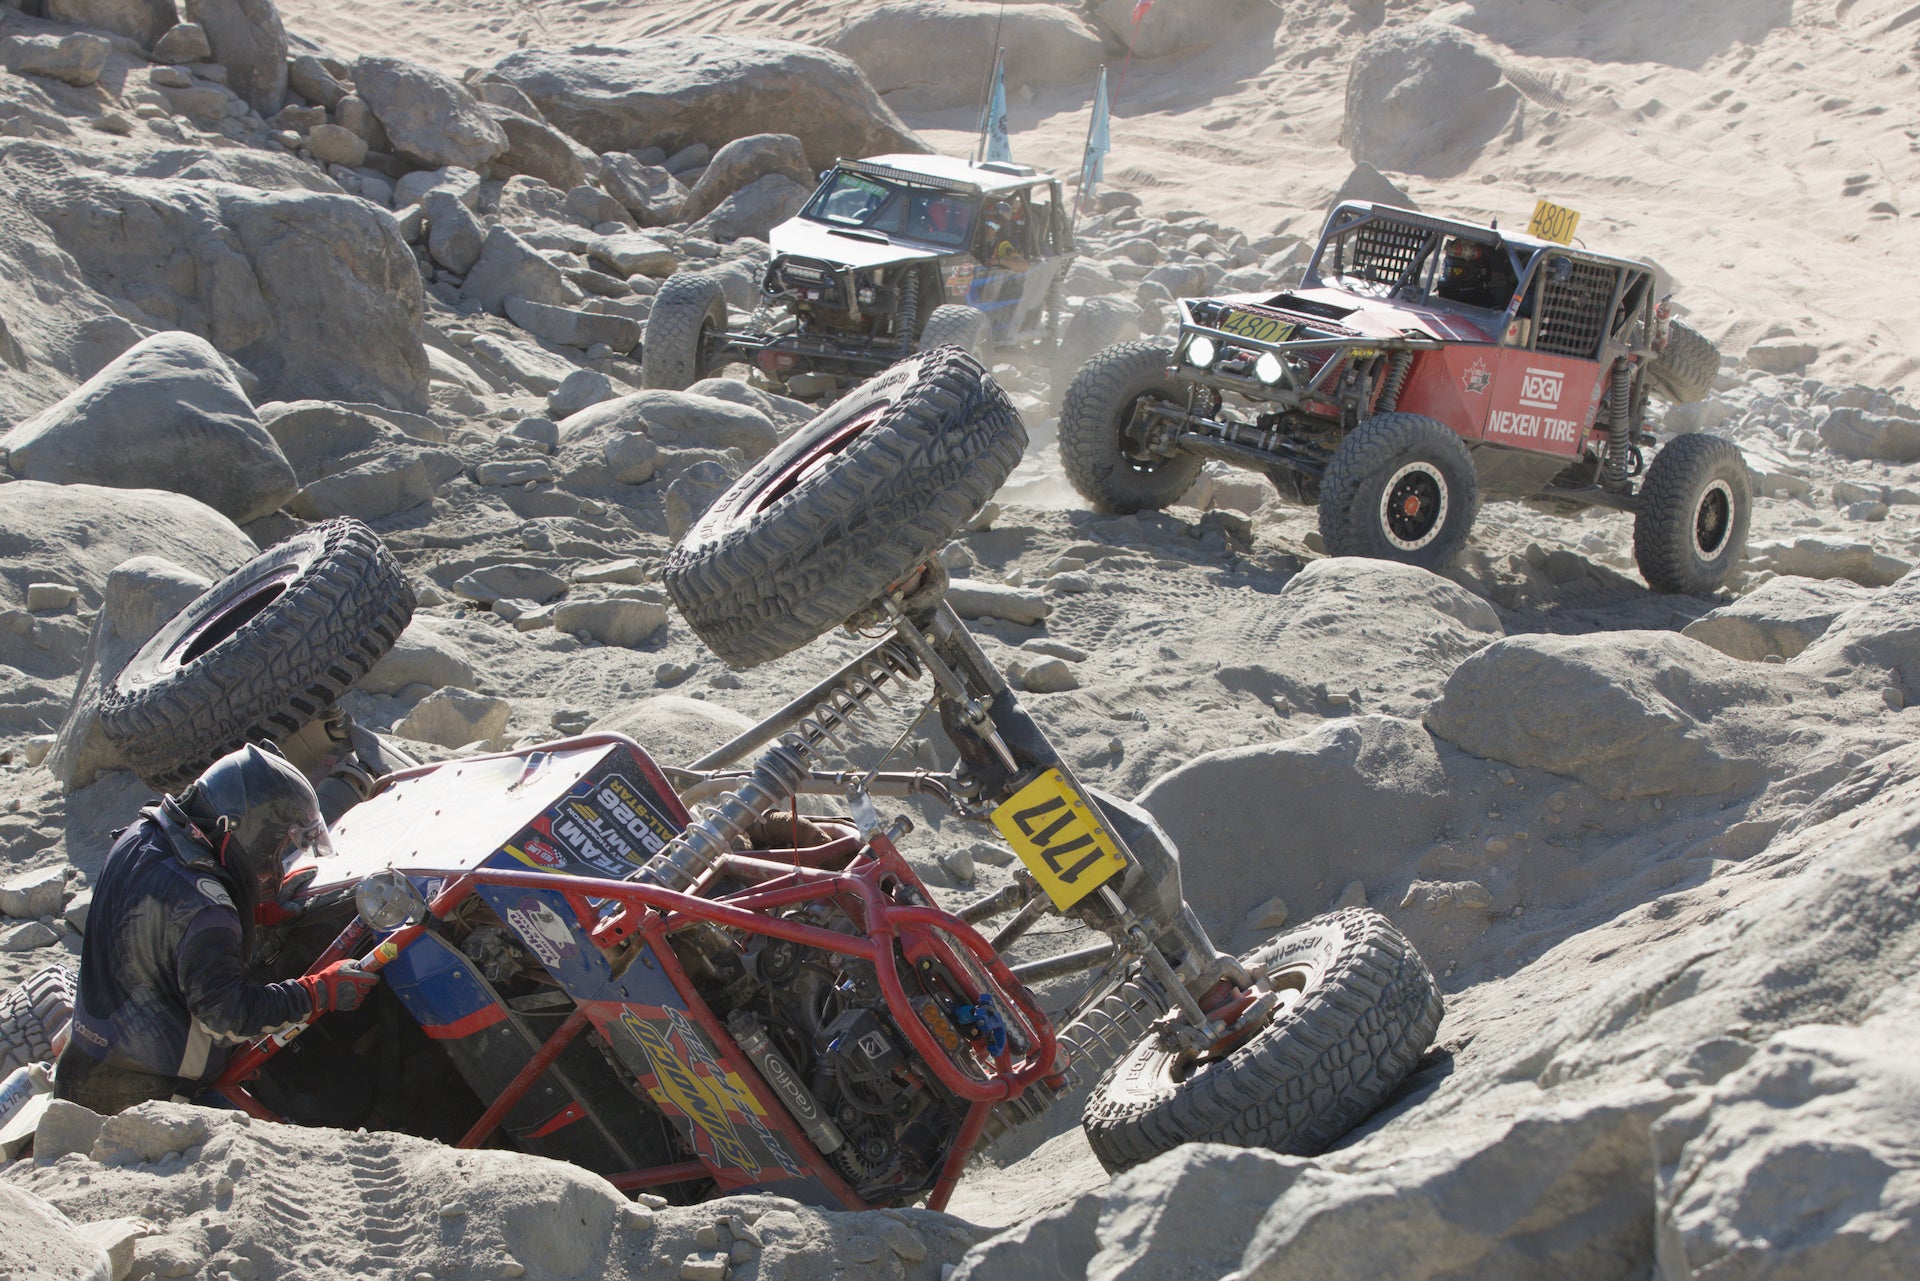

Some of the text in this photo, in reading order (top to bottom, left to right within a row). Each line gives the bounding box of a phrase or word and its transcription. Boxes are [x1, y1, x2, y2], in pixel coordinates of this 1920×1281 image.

[1533, 202, 1575, 240] 4801
[1224, 314, 1294, 342] 4801
[1489, 410, 1541, 438] NEXEN
[1543, 418, 1577, 443] TIRE
[567, 807, 611, 852] THOMPSON
[587, 818, 632, 856] M/T
[597, 788, 666, 853] 2026
[610, 780, 674, 840] ALL-STAR
[558, 820, 624, 874] TEAM
[1012, 795, 1105, 884] 1717
[509, 913, 552, 963] Yukon
[631, 1025, 748, 1161] SUNOCO
[662, 1004, 803, 1177] RACE FUELS
[767, 1059, 811, 1113] radflo
